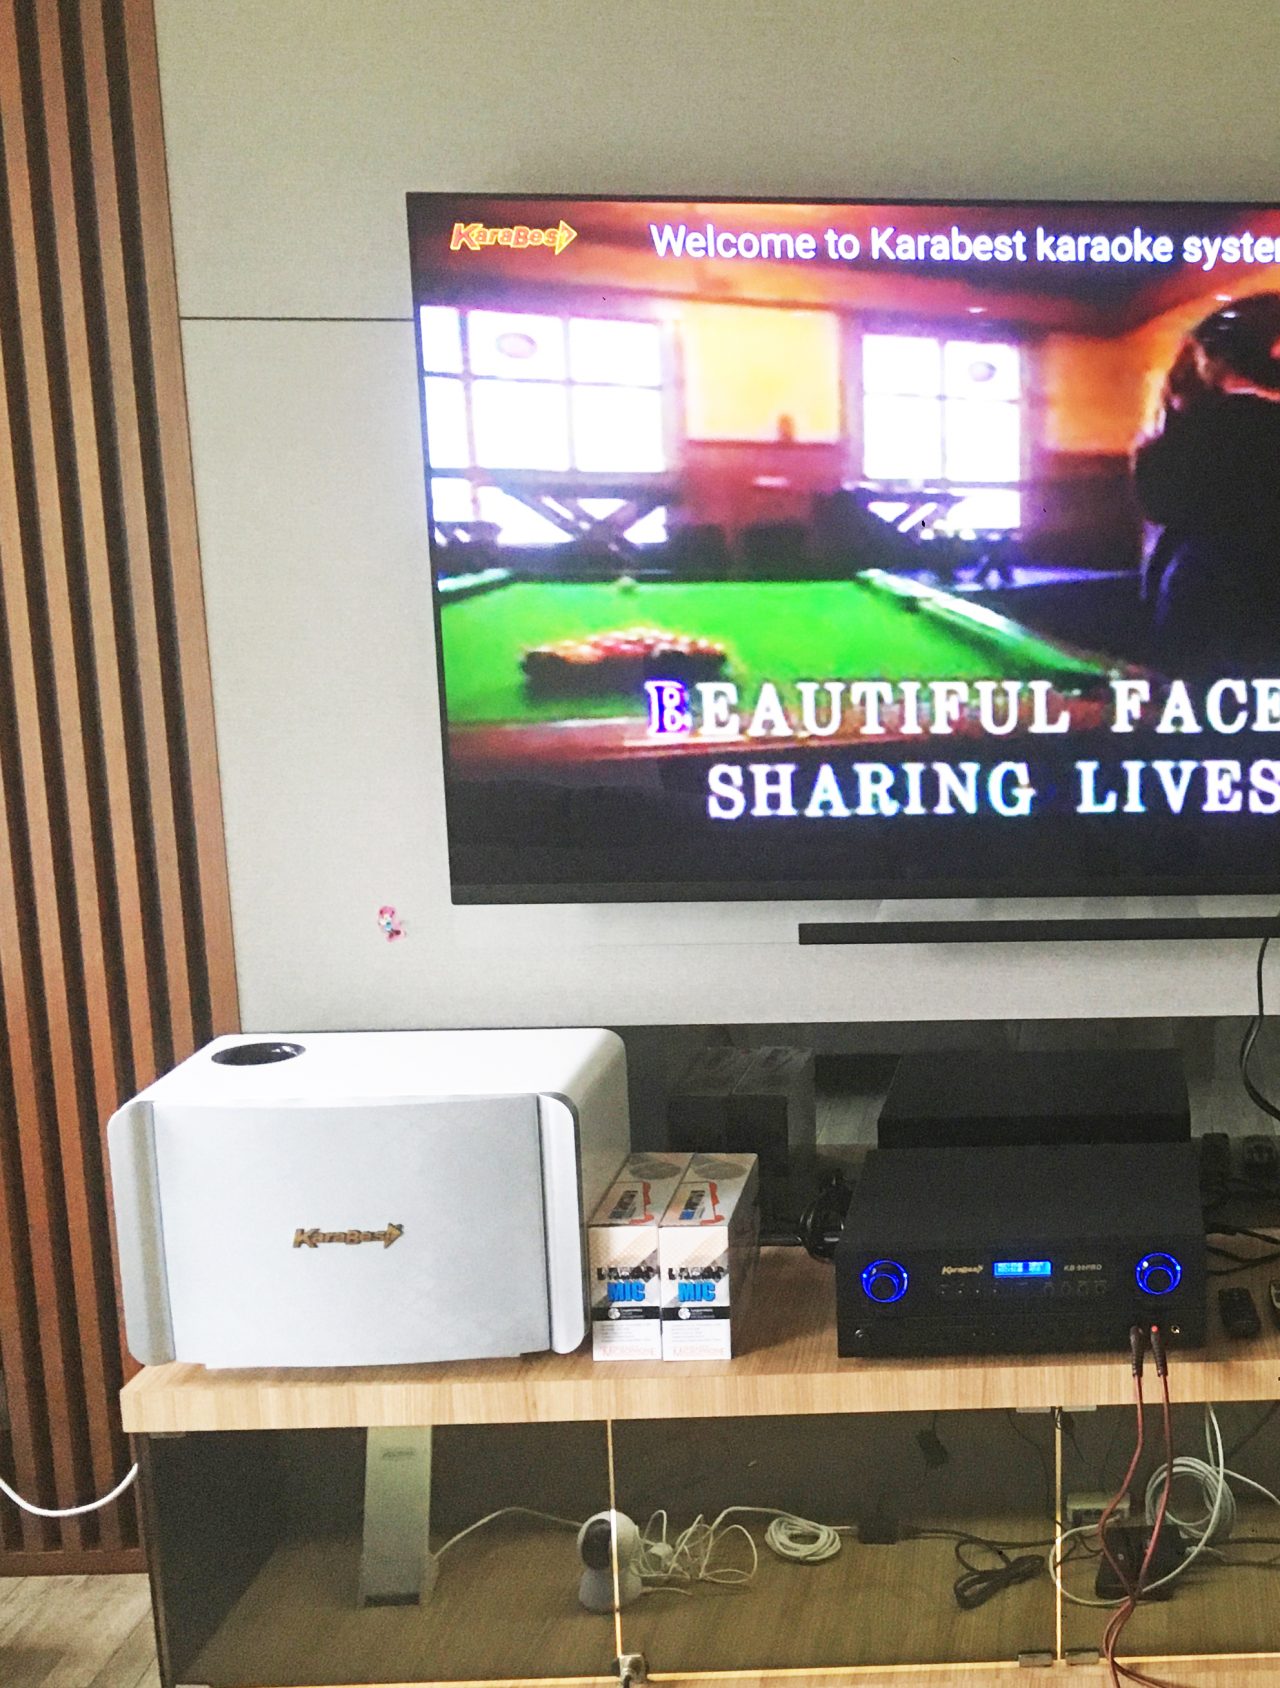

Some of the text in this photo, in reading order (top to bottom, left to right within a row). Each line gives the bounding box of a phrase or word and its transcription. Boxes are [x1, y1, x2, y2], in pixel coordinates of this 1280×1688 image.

[650, 223, 816, 260] Welcome
[825, 228, 860, 261] to
[871, 226, 1028, 263] Karabest
[1036, 227, 1173, 264] karaoke
[644, 679, 1071, 737] BEAUTIFUL
[706, 761, 1037, 820] SHARING
[606, 1280, 646, 1302] MIC
[677, 1280, 717, 1303] MIC
